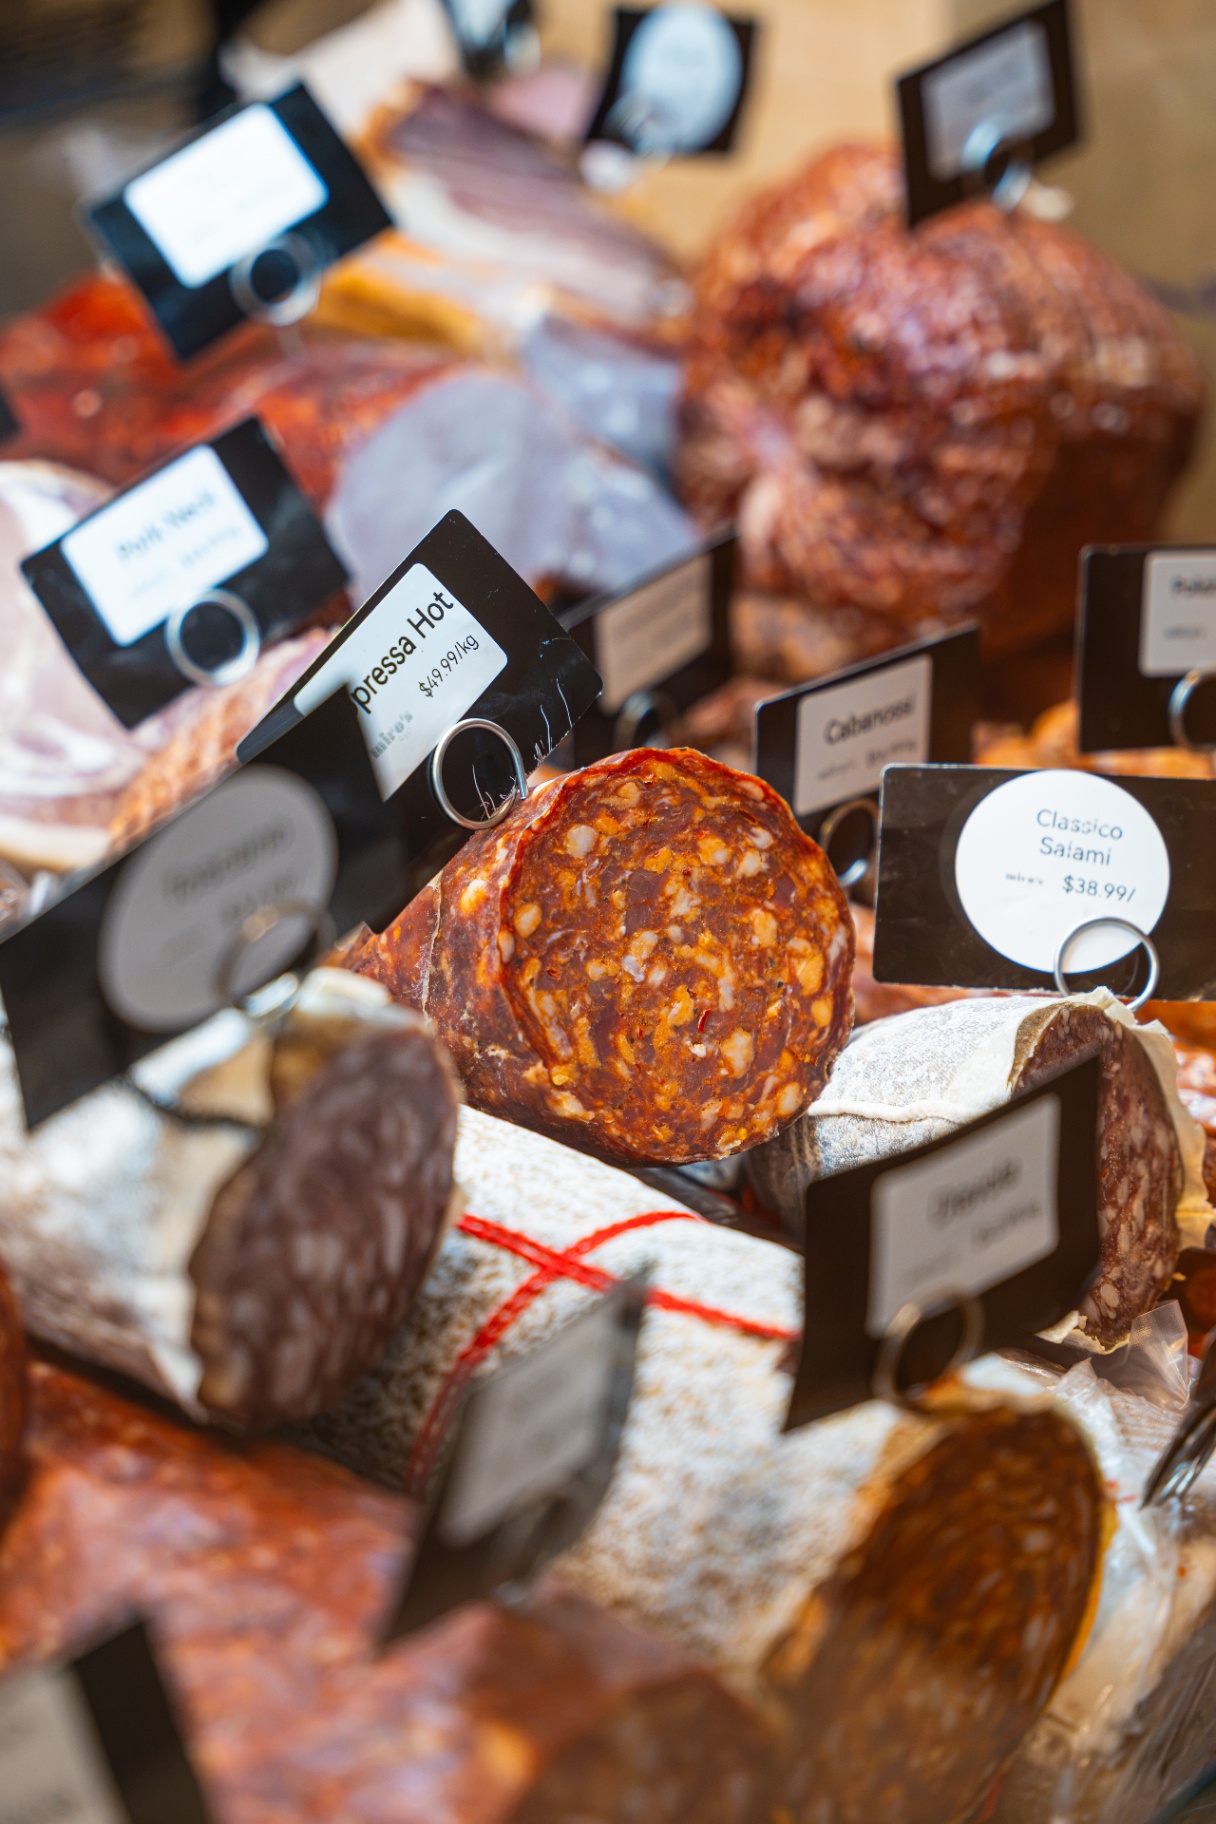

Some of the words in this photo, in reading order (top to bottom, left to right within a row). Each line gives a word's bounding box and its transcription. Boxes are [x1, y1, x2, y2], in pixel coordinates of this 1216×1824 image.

[351, 635, 417, 714] pressa
[407, 592, 454, 639] Hot
[418, 634, 479, 698] $49.99/kg
[1036, 808, 1123, 840] Classico
[1039, 836, 1112, 866] Salami
[1062, 874, 1136, 902] $38.99/
